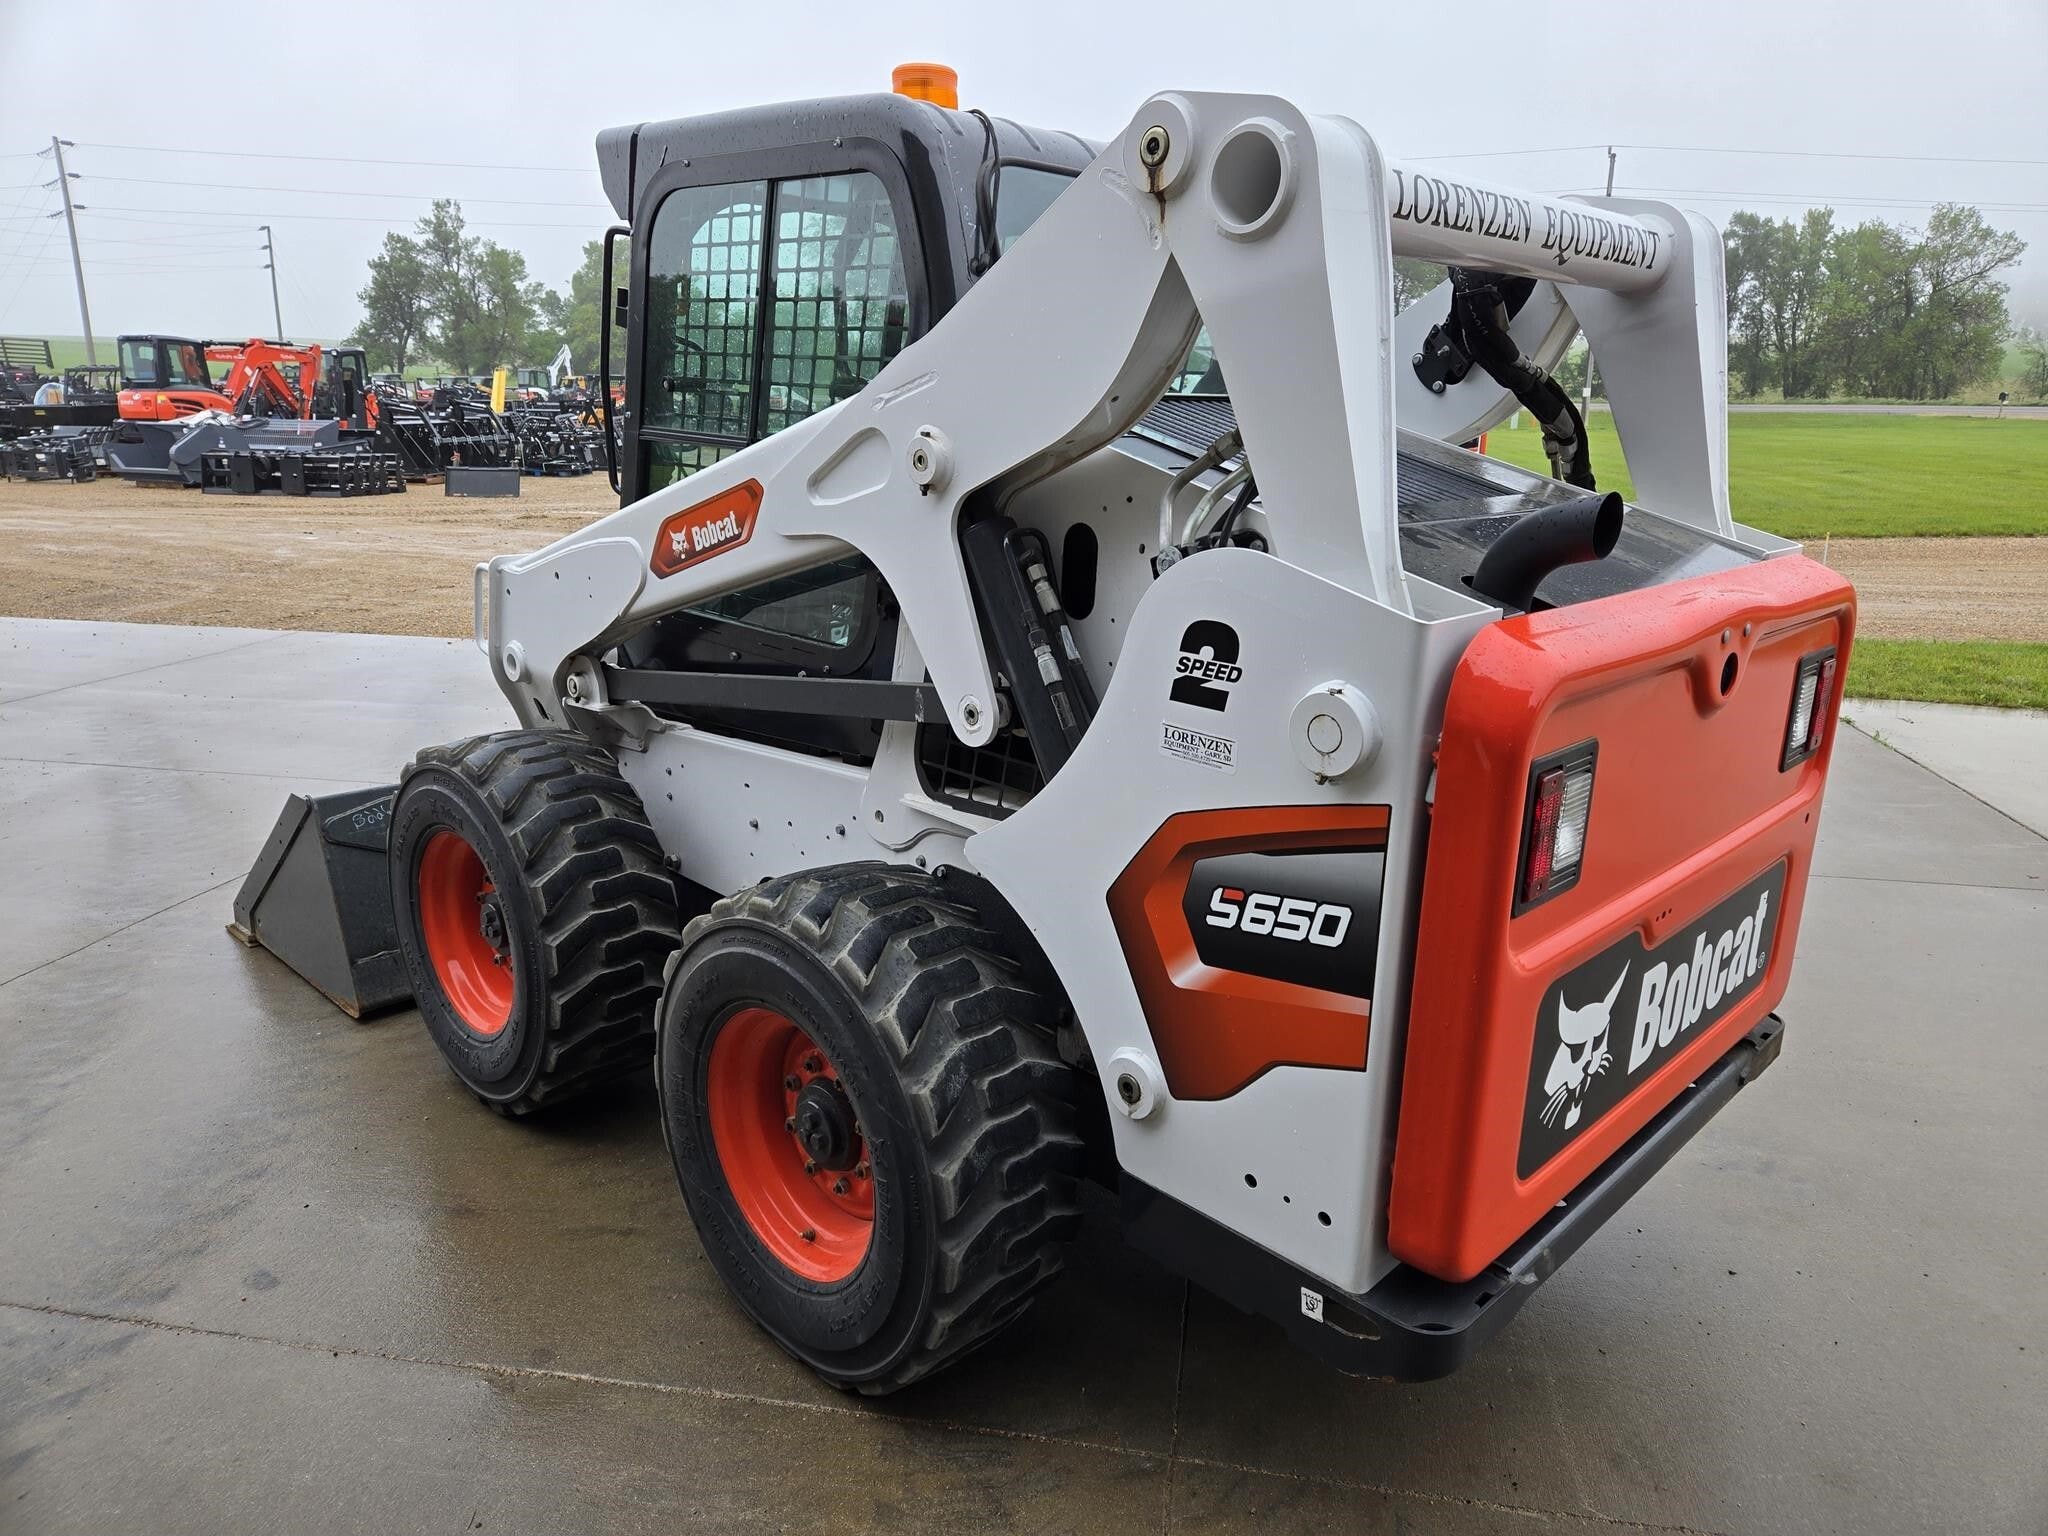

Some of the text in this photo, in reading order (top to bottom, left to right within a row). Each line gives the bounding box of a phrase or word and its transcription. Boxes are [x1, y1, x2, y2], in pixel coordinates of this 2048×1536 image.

[1392, 168, 1661, 269] LORENZEN EQUIPMENT
[691, 510, 739, 551] Bobcat
[1169, 619, 1240, 712] 2
[1175, 656, 1243, 684] SPEED
[1163, 739, 1199, 753] EQUIPMENT
[1164, 727, 1233, 755] LORENZEN
[1206, 887, 1352, 948] S650
[1628, 890, 1769, 1075] Bobcat
